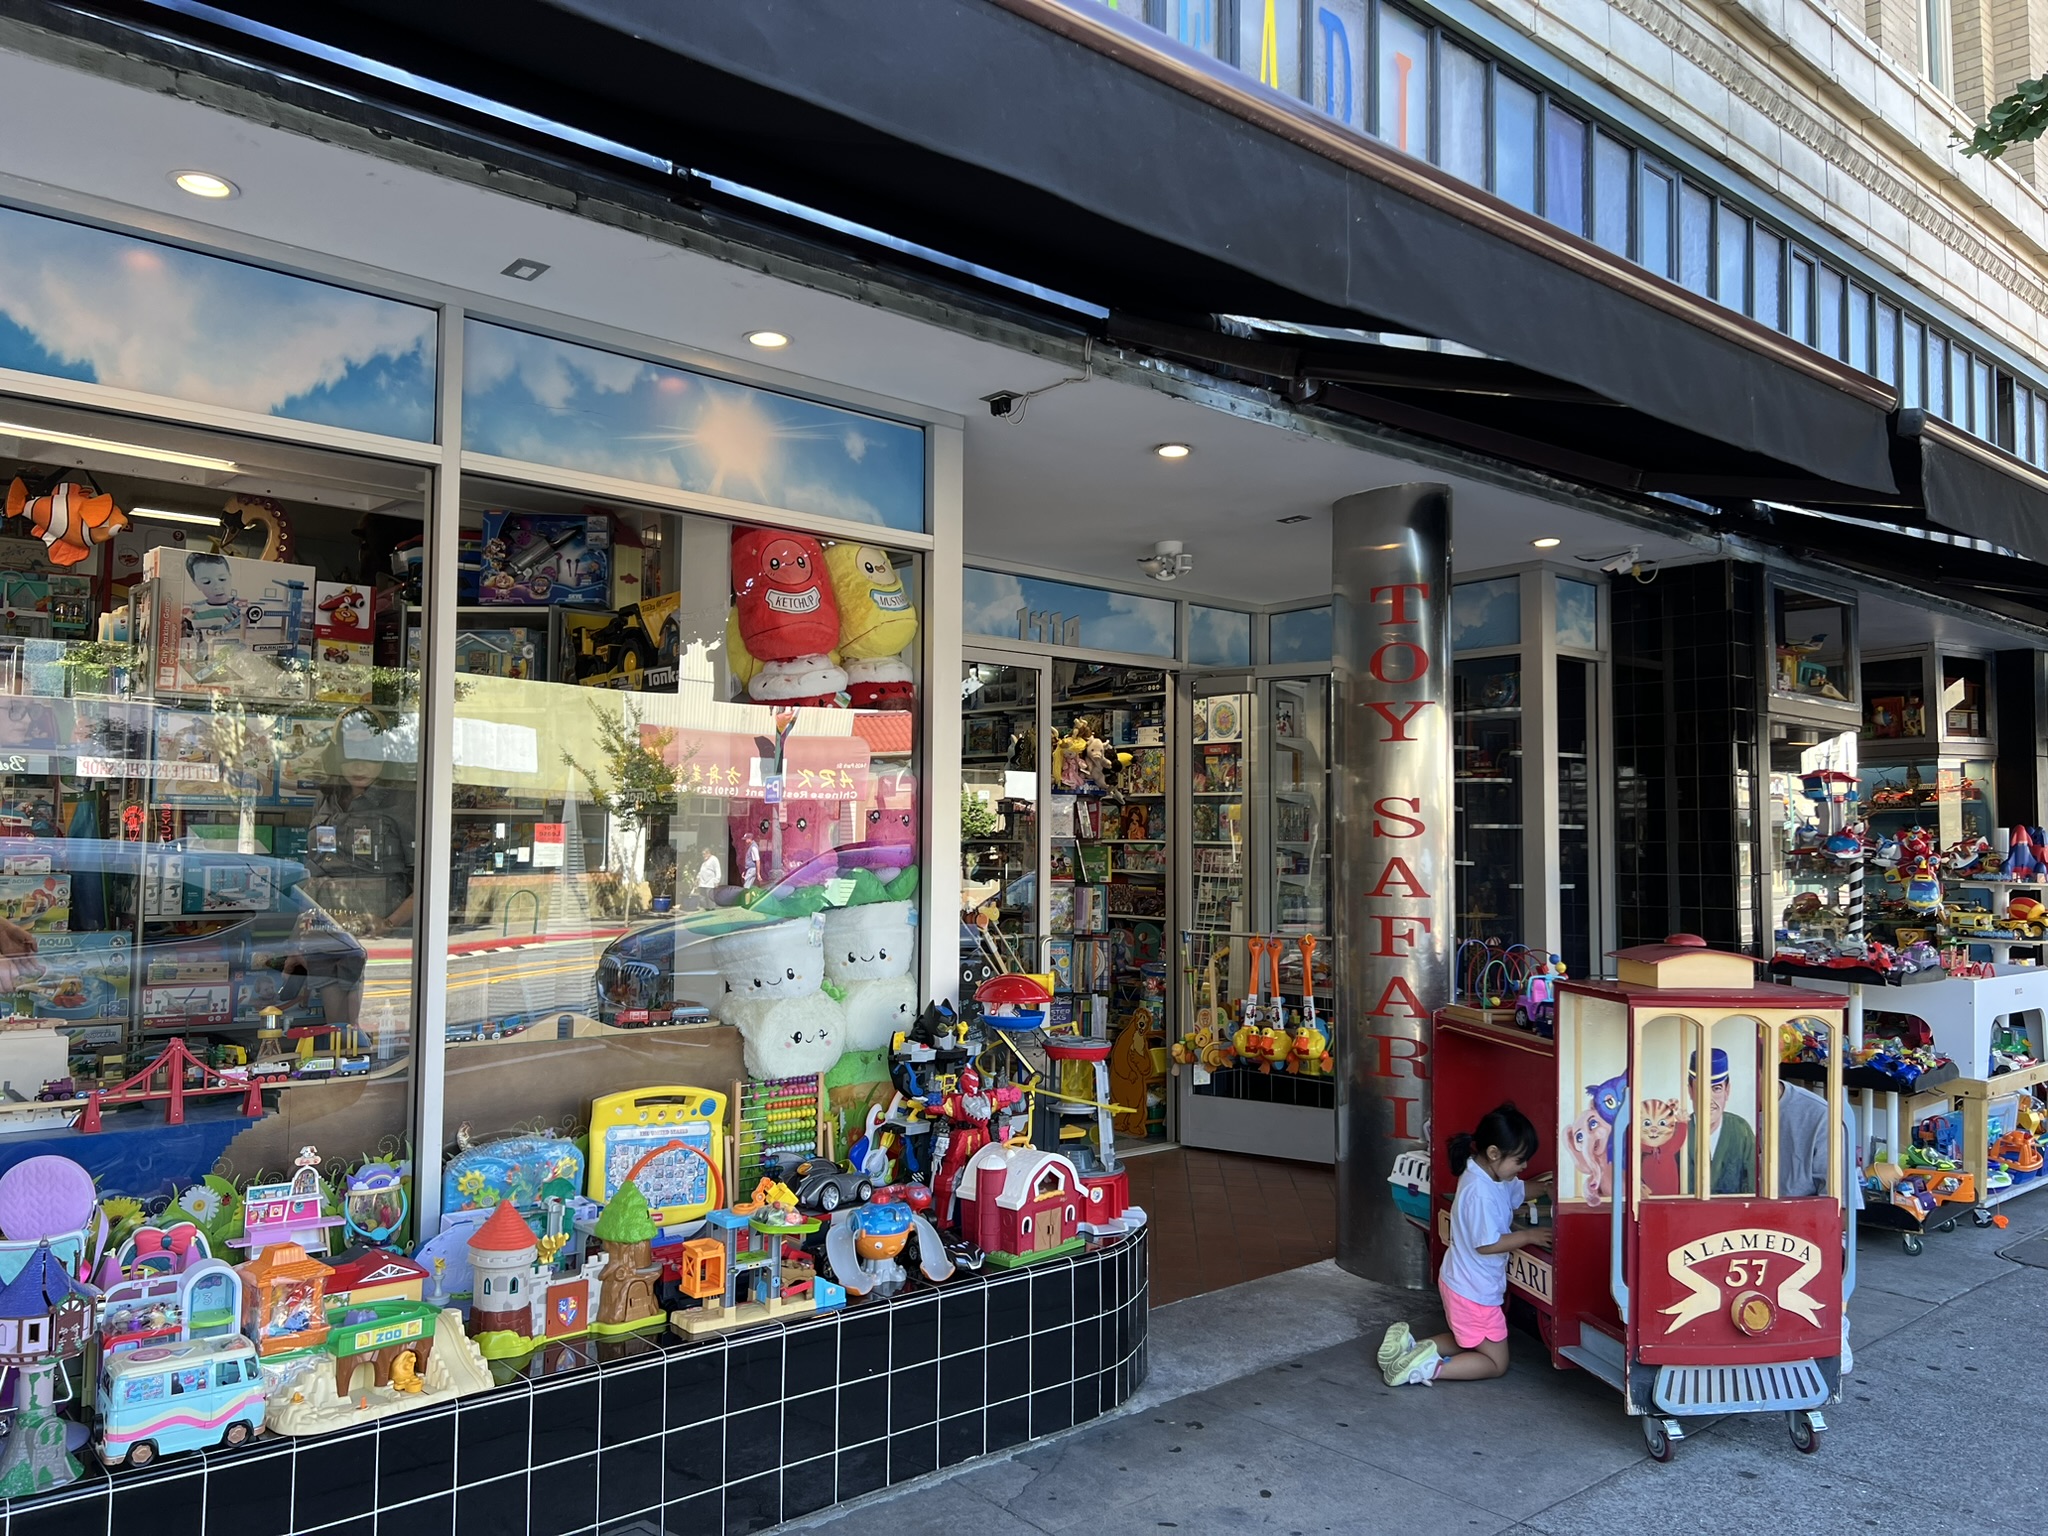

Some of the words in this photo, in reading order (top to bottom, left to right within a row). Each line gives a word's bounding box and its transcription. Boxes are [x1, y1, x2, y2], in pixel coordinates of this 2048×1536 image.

[775, 593, 815, 608] KETCHUP
[643, 666, 679, 687] Tonka
[1364, 582, 1436, 742] TOY
[38, 937, 73, 948] AQUA
[1363, 796, 1434, 1140] SAFARI
[1682, 1234, 1811, 1266] ALAMEDA
[1506, 1252, 1548, 1297] FARI
[1725, 1258, 1768, 1287] 57
